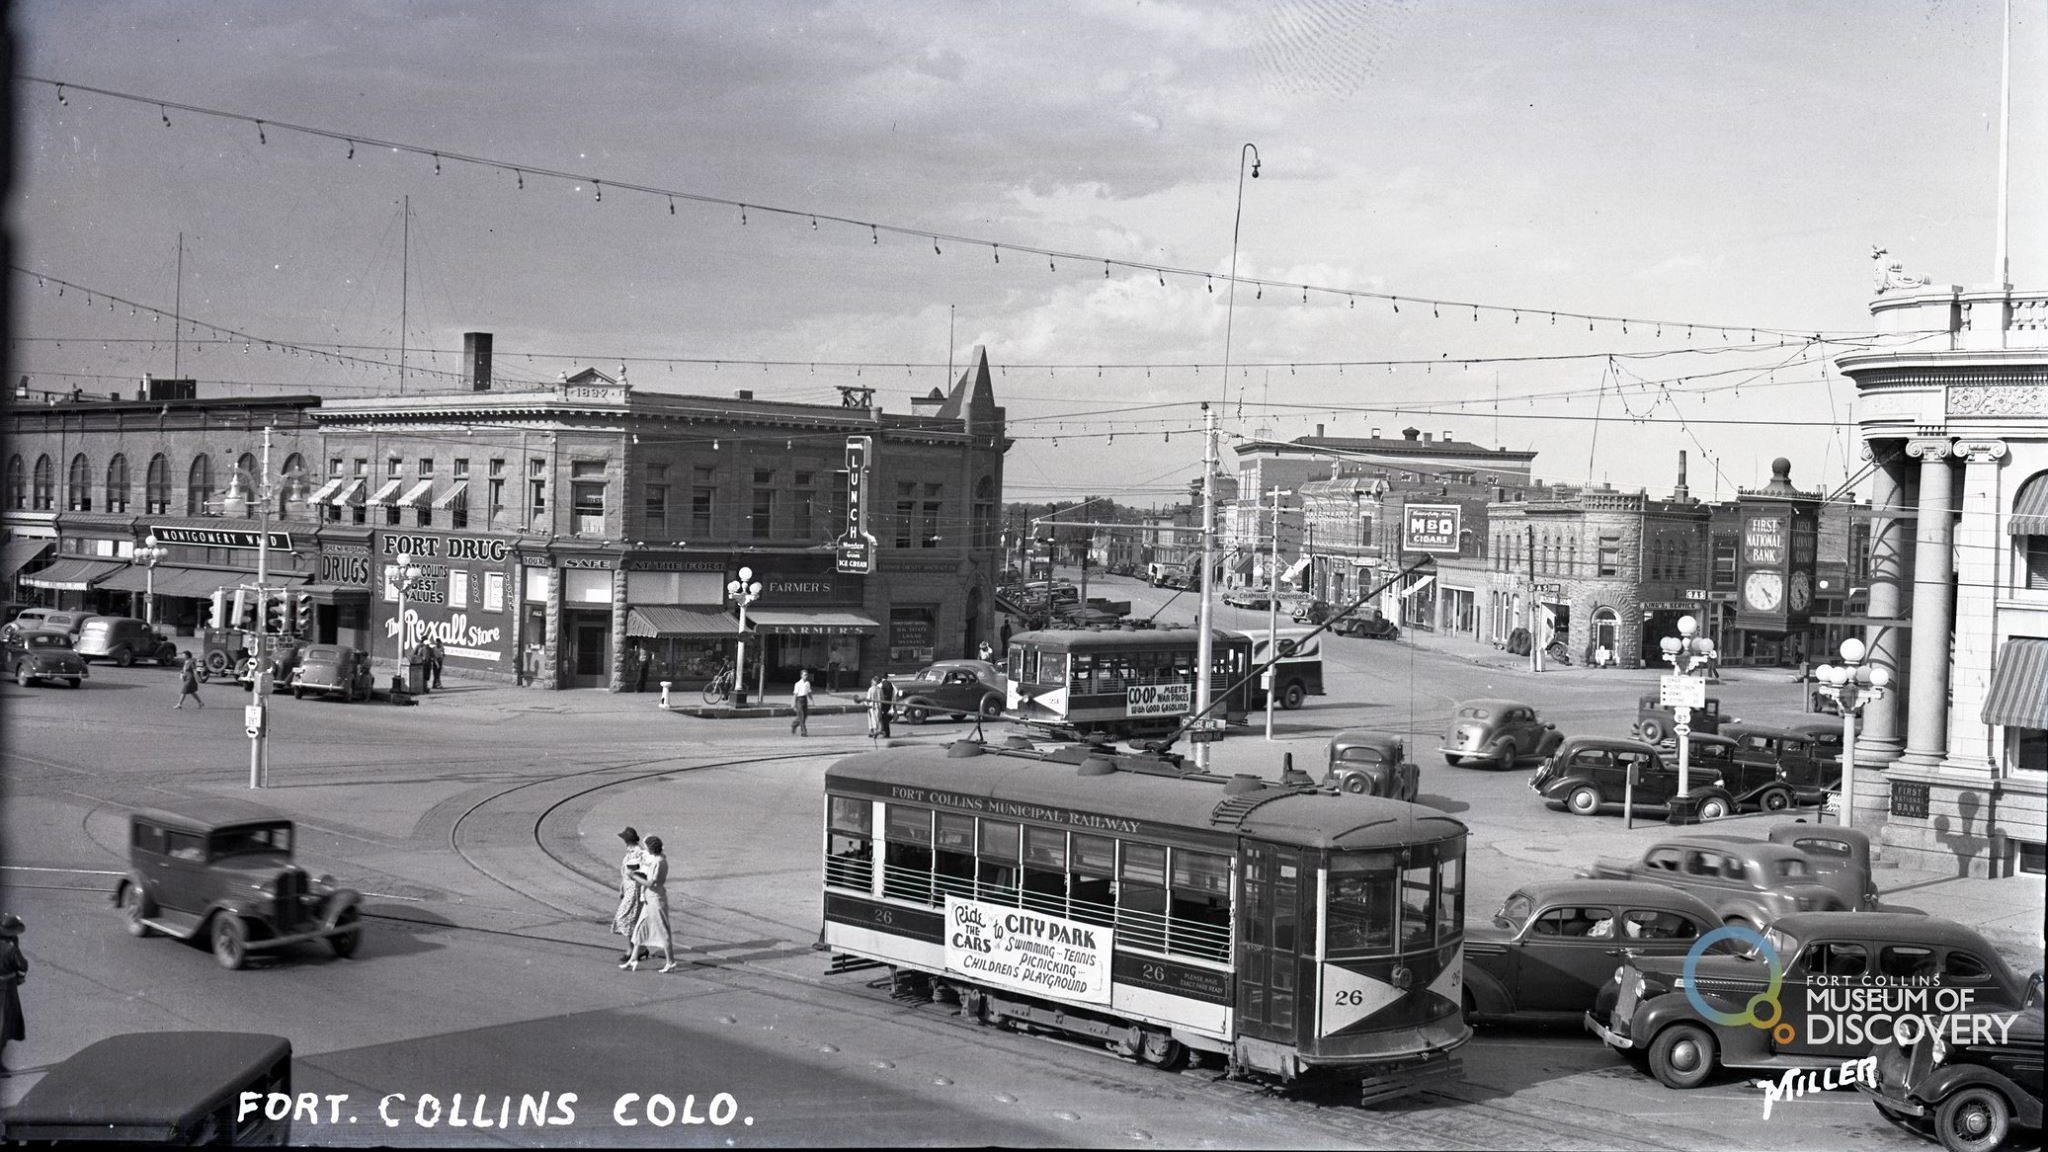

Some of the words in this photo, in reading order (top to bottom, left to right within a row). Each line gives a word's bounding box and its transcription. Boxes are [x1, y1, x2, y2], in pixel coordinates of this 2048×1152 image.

[850, 455, 859, 539] LUNCH
[1752, 519, 1778, 533] FIRST
[162, 530, 236, 544] MONTGOMERY
[245, 534, 277, 546] WAD
[1413, 535, 1448, 544] CIGARS
[1746, 534, 1780, 547] NATIONAL
[383, 535, 439, 556] FORT
[447, 537, 507, 562] DRUG
[1753, 548, 1776, 562] BANK
[322, 555, 369, 584] DRUGS
[565, 559, 611, 569] SAFE
[631, 560, 649, 569] AT
[655, 560, 680, 569] THE
[685, 561, 725, 570] FORT
[411, 580, 437, 590] BEST
[405, 592, 443, 604] VALUES
[404, 609, 467, 650] Rexall
[467, 626, 500, 647] Store
[774, 626, 863, 634] FARMER'S
[1129, 687, 1157, 704] CO-OP
[1163, 685, 1188, 694] MEETS
[1897, 786, 1922, 796] FIRST
[891, 786, 924, 800] FORT
[929, 791, 983, 810] COLLINS
[988, 800, 1063, 823] MUNICIPAL
[1069, 811, 1141, 834] RAILWAY
[1897, 803, 1921, 812] BANK
[874, 909, 893, 925] 26
[955, 905, 987, 928] Ride
[966, 924, 981, 936] THE
[993, 919, 1004, 939] to
[1005, 914, 1046, 938] CITY
[1049, 922, 1096, 949] PARK
[952, 932, 992, 953] CARS
[1143, 963, 1165, 981] 26
[1022, 969, 1088, 993] PLAYGROUND
[1335, 990, 1363, 1006] 26
